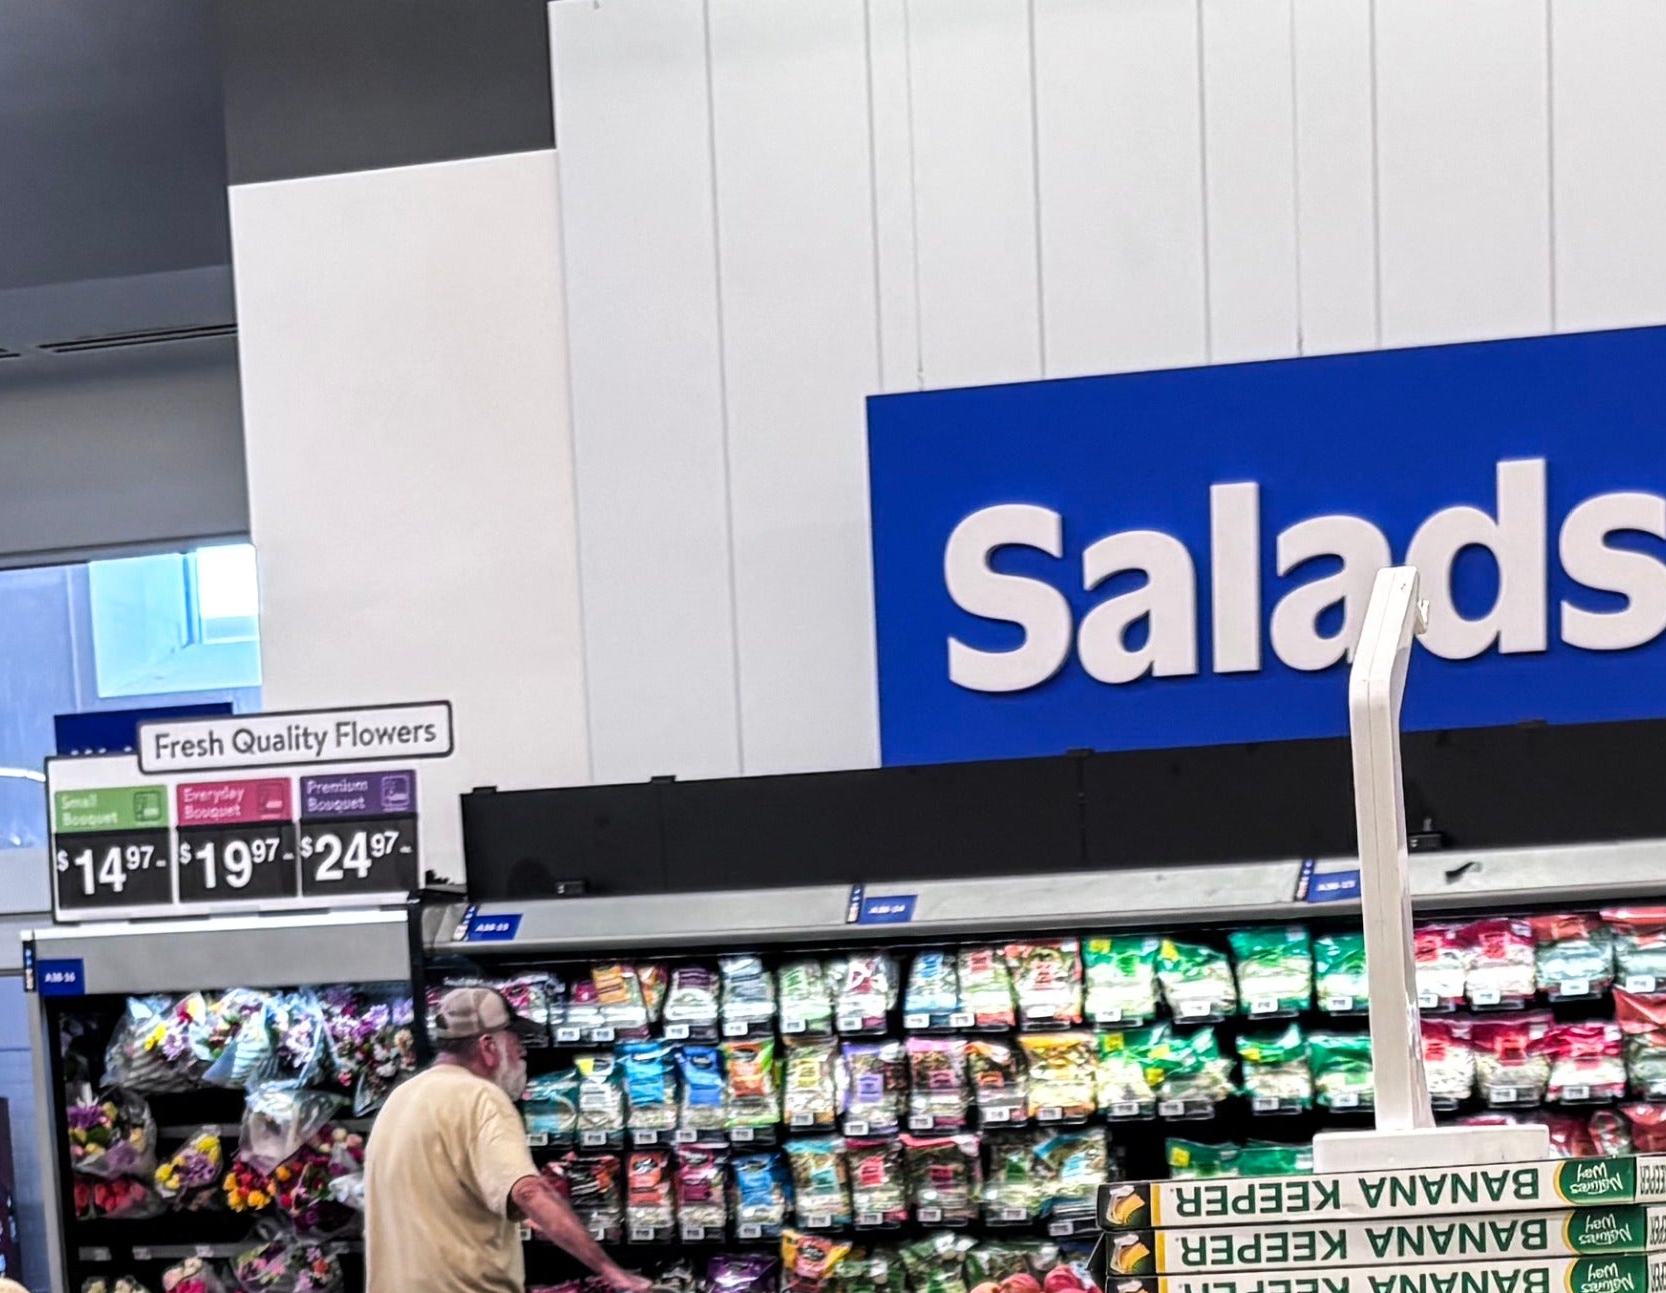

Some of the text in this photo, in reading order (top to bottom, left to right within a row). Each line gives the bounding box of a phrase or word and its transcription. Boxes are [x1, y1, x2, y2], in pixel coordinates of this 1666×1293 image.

[154, 722, 436, 760] Fresh Quality Flowers
[183, 786, 244, 805] Everyday
[307, 778, 368, 795] Premium
[184, 803, 242, 820] Bouquet
[308, 796, 366, 813] Bouquet
[1176, 1168, 1539, 1217] BANANA KEEPER
[1181, 1219, 1548, 1265] BANANA KEEPER
